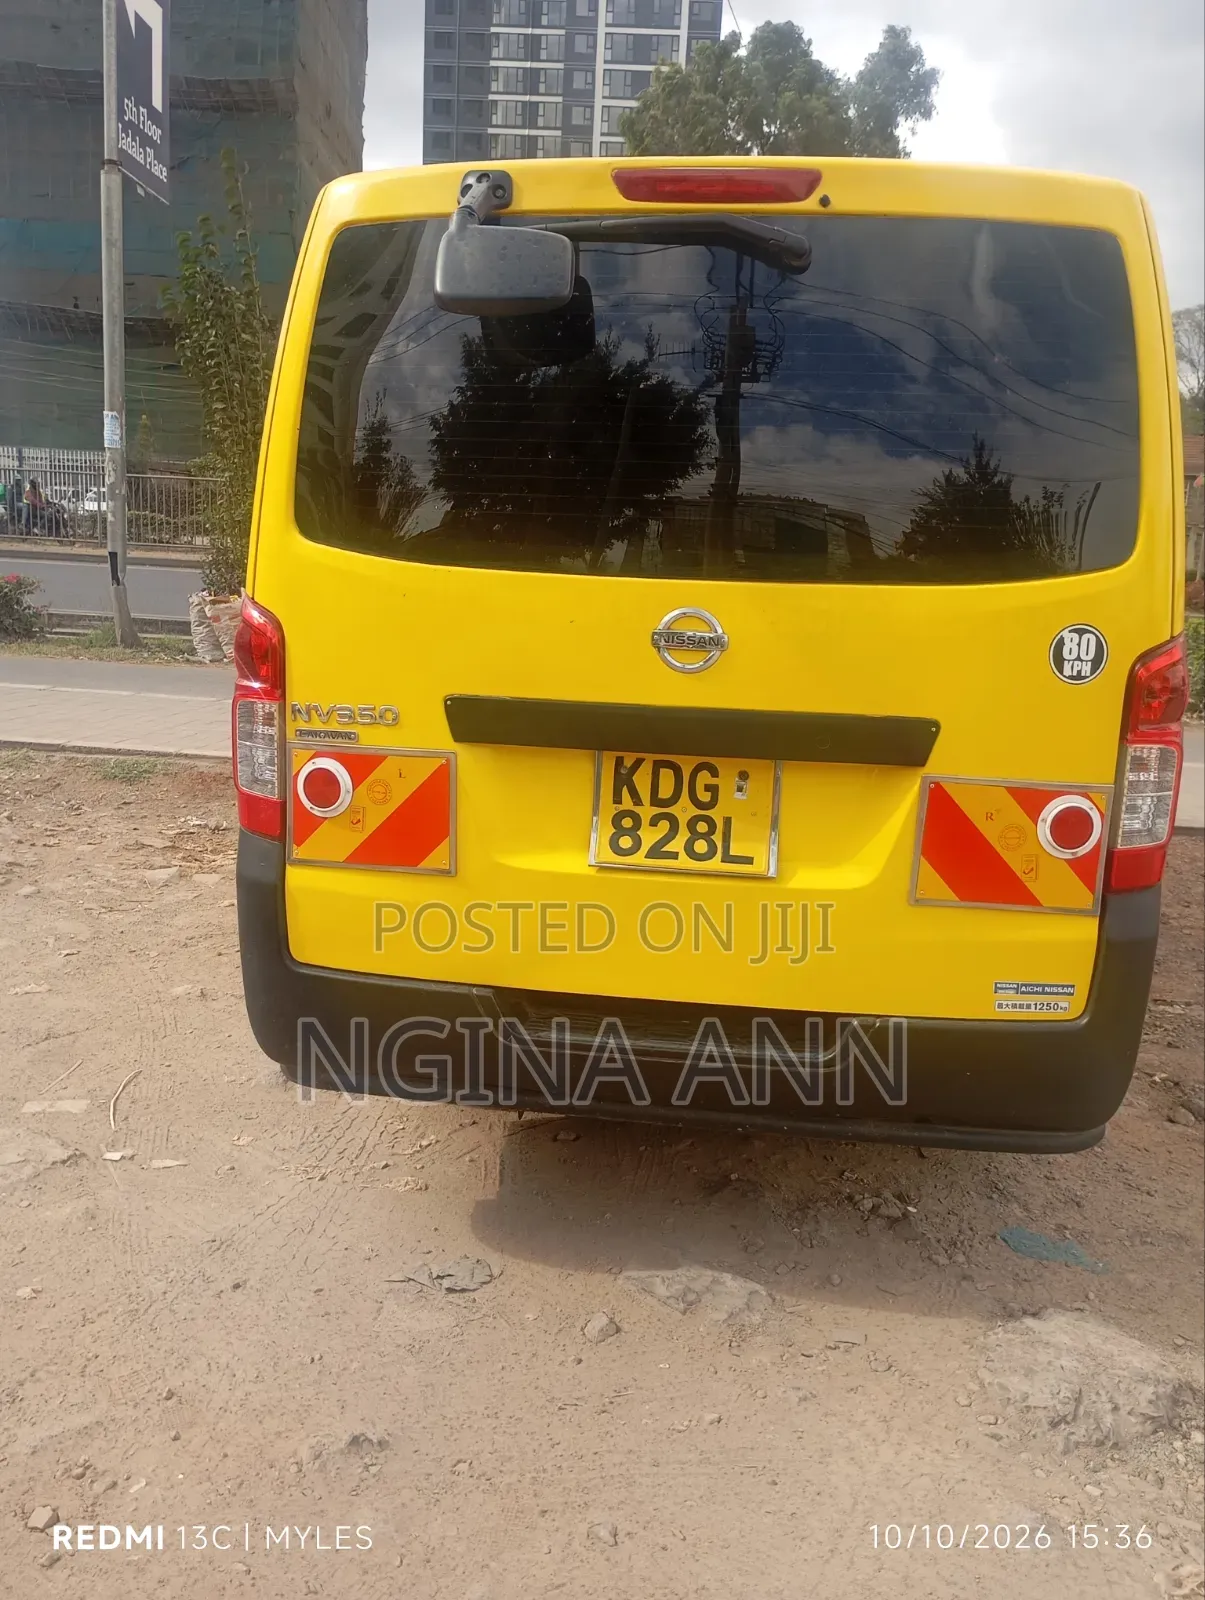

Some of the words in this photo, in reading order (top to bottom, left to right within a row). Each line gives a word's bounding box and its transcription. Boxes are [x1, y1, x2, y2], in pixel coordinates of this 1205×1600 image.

[124, 96, 138, 124] 5th
[139, 106, 161, 144] Floor
[118, 122, 144, 165] Jadala
[146, 146, 168, 183] Place
[660, 634, 720, 647] NISSAN
[1062, 632, 1097, 661] 80
[1063, 660, 1092, 677] KPH
[291, 701, 399, 726] NV350
[612, 755, 720, 811] KDG
[985, 811, 995, 822] R
[608, 808, 755, 866] 828L
[1020, 985, 1043, 993] AICHI
[1044, 986, 1074, 994] NISSAN
